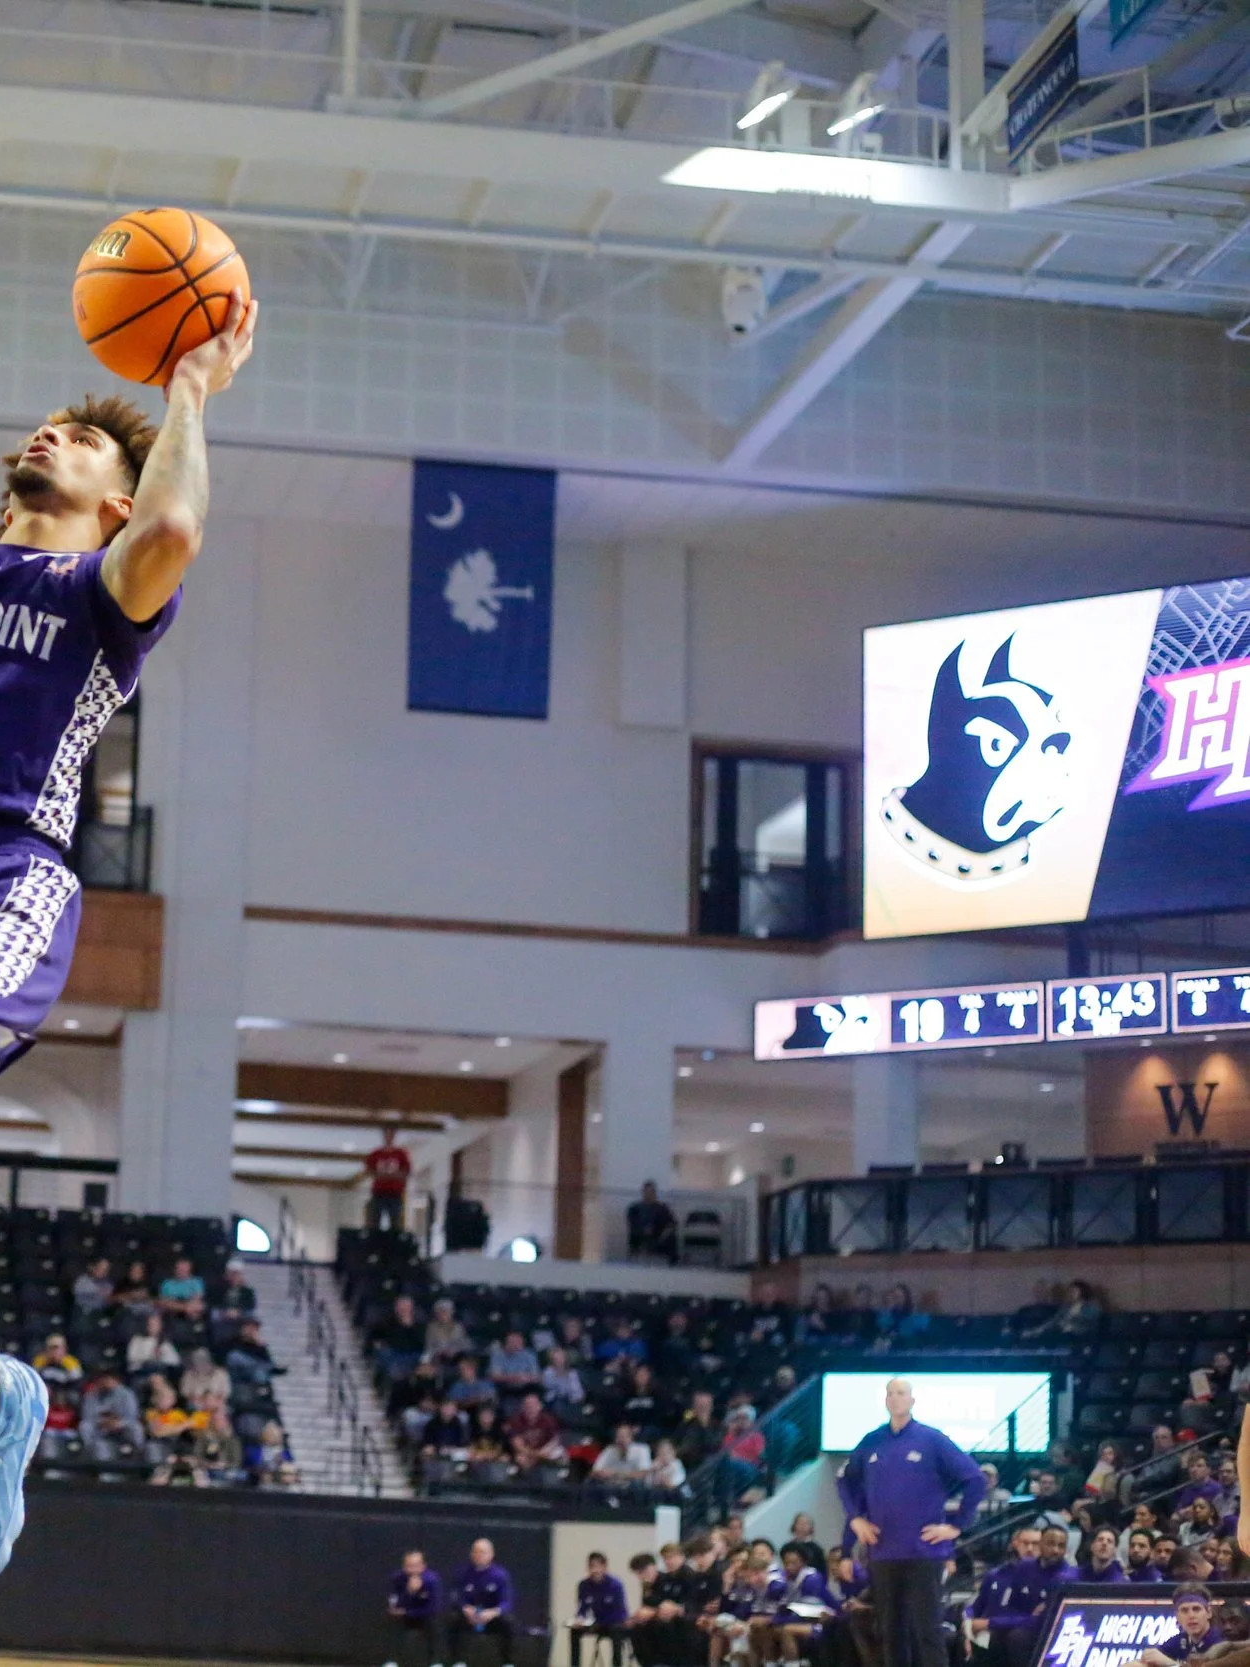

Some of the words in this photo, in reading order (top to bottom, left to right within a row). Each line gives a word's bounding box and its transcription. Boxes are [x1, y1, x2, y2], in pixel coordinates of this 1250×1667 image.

[1058, 980, 1156, 1021] 13:43
[1155, 1082, 1219, 1136] W
[1094, 1614, 1143, 1645] HIGH
